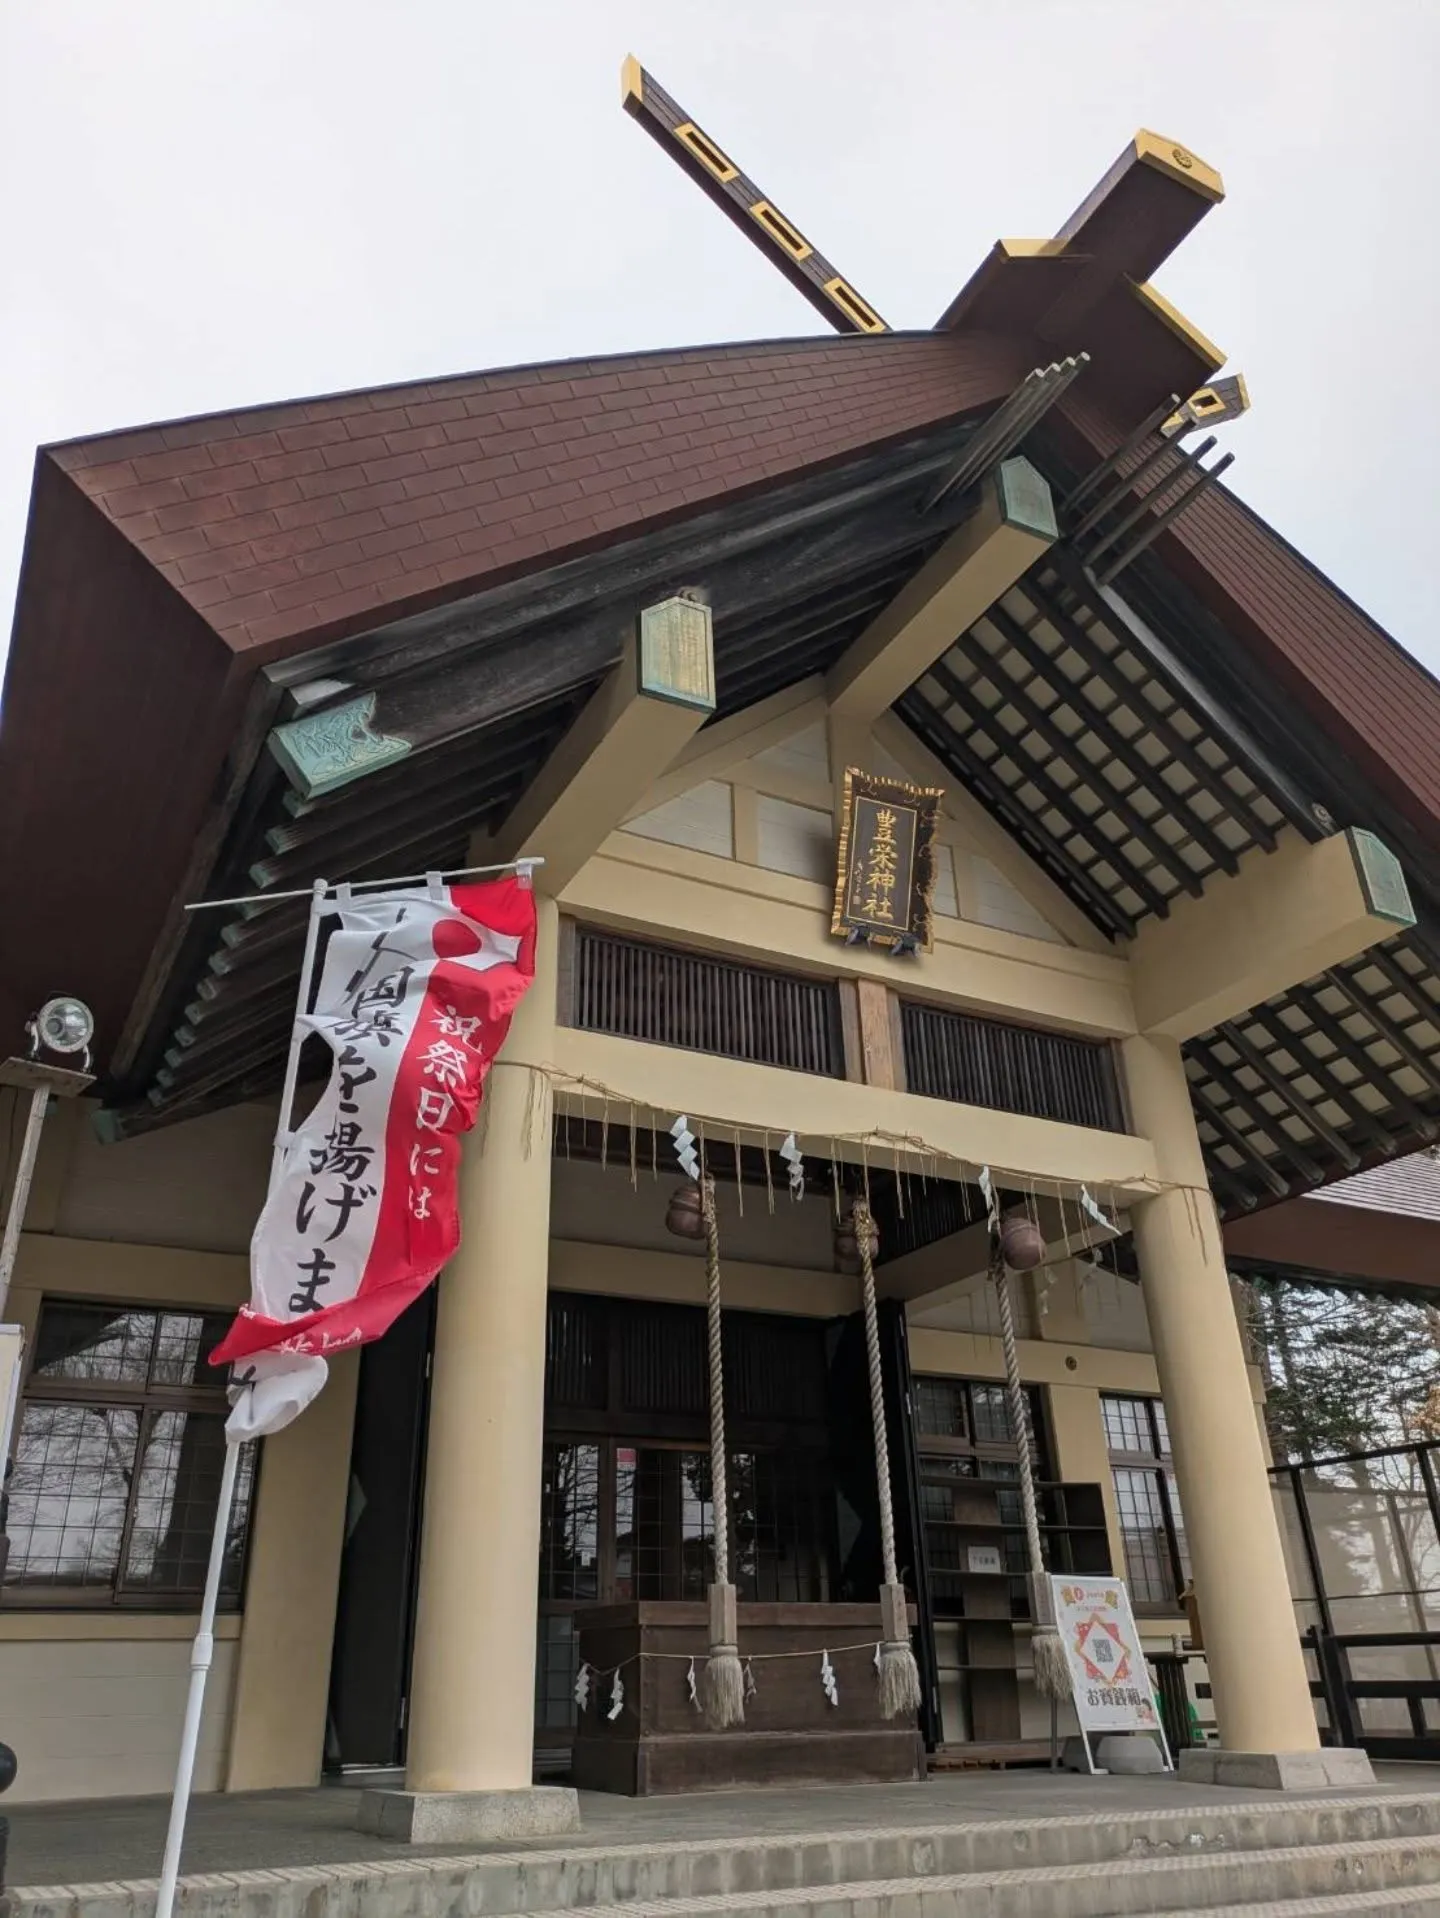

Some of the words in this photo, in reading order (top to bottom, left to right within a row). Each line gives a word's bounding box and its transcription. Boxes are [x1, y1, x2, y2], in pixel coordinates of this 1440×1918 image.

[407, 1004, 484, 1218] 祝祭日には
